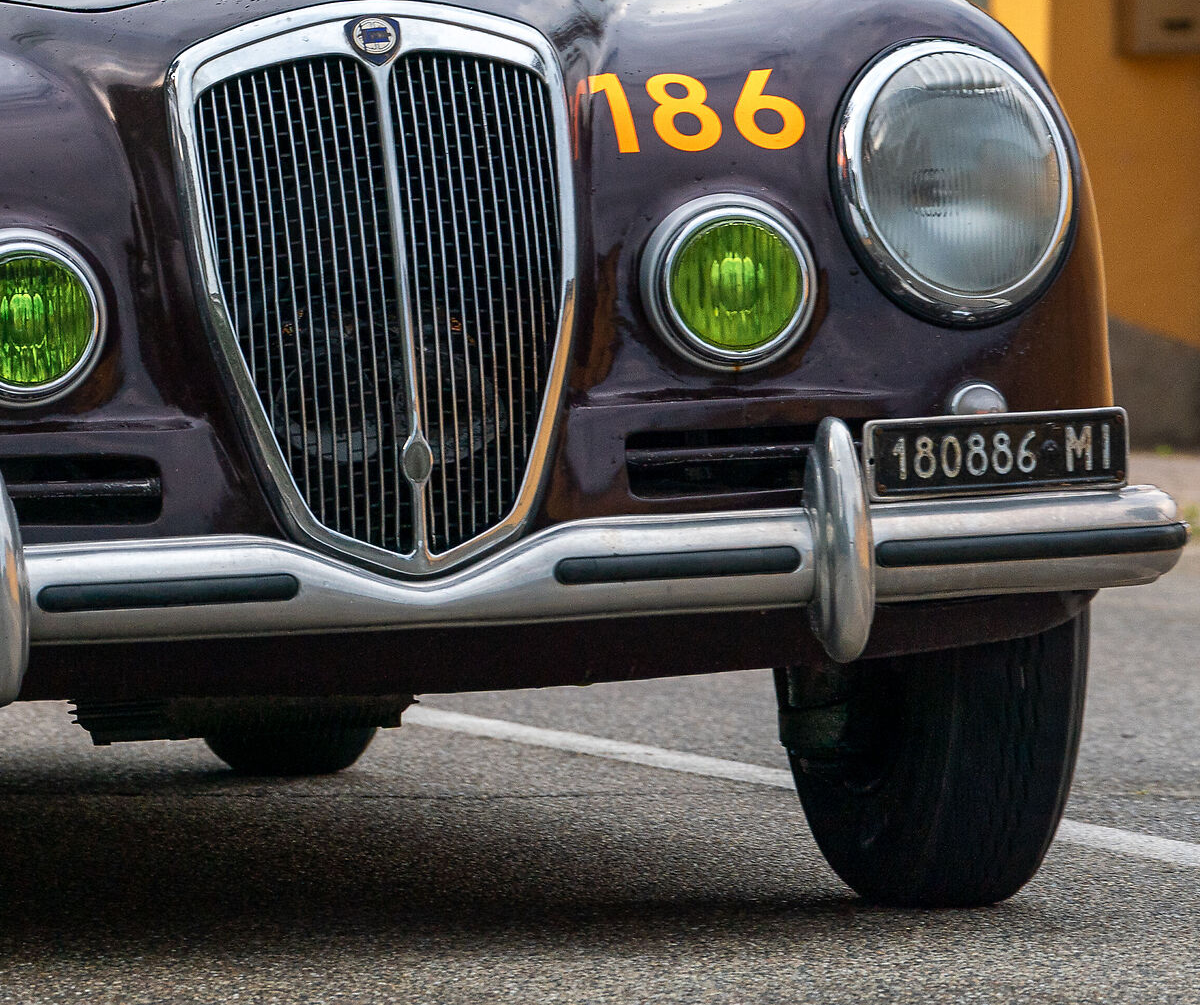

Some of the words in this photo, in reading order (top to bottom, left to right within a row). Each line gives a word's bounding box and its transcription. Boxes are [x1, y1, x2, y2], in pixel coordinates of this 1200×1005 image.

[587, 68, 806, 154] 186
[891, 430, 1038, 481] 180886
[1064, 423, 1111, 473] MI
